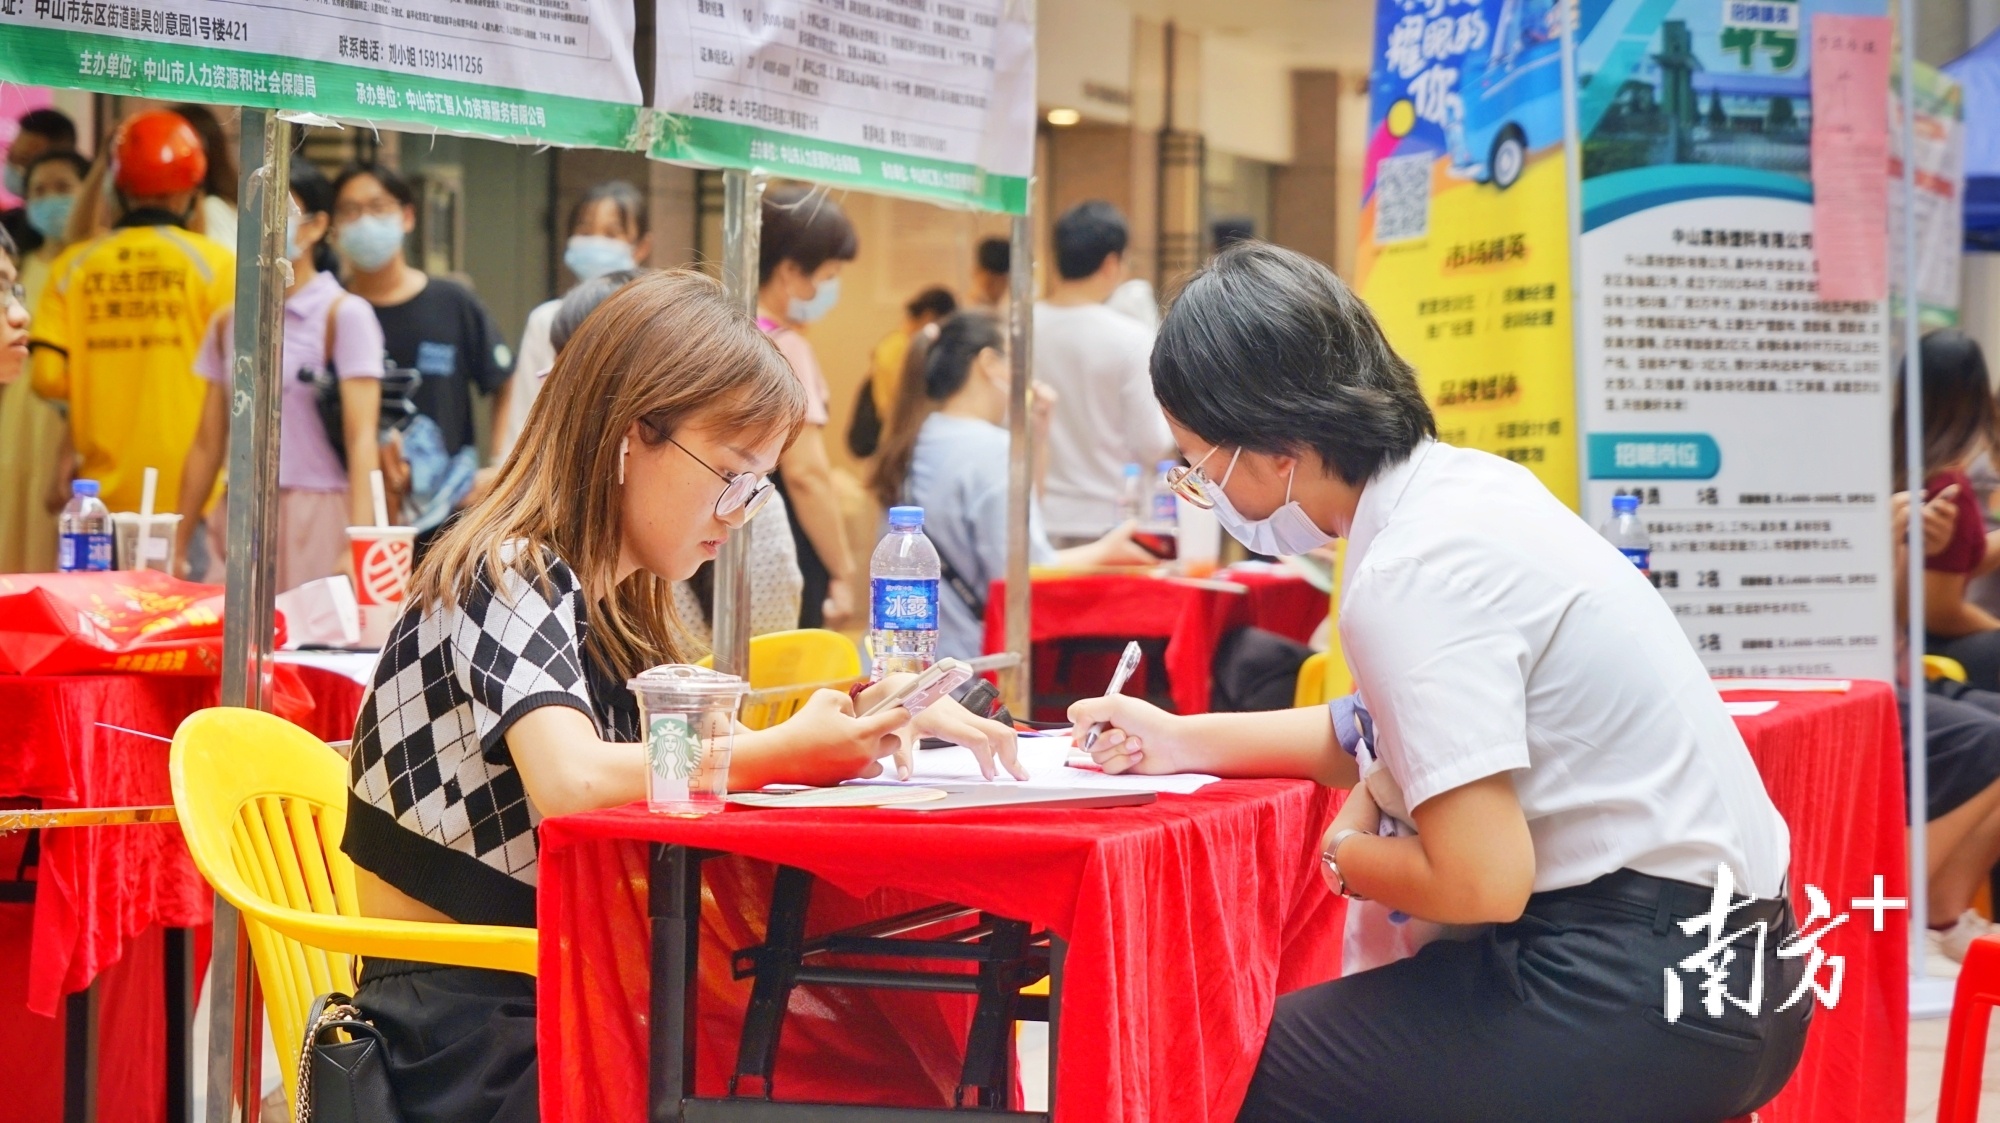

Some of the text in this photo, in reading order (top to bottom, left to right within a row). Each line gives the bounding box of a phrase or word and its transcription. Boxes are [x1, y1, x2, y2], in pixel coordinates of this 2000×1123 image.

[79, 50, 317, 98] 主办单位：中山市人力资源和社会保障局
[418, 47, 483, 75] 15913411256
[356, 81, 546, 128] 承办单位：中山市汇智人力资源服务有限公司
[1614, 442, 1698, 468] 招聘岗位
[885, 595, 928, 618] 冰露
